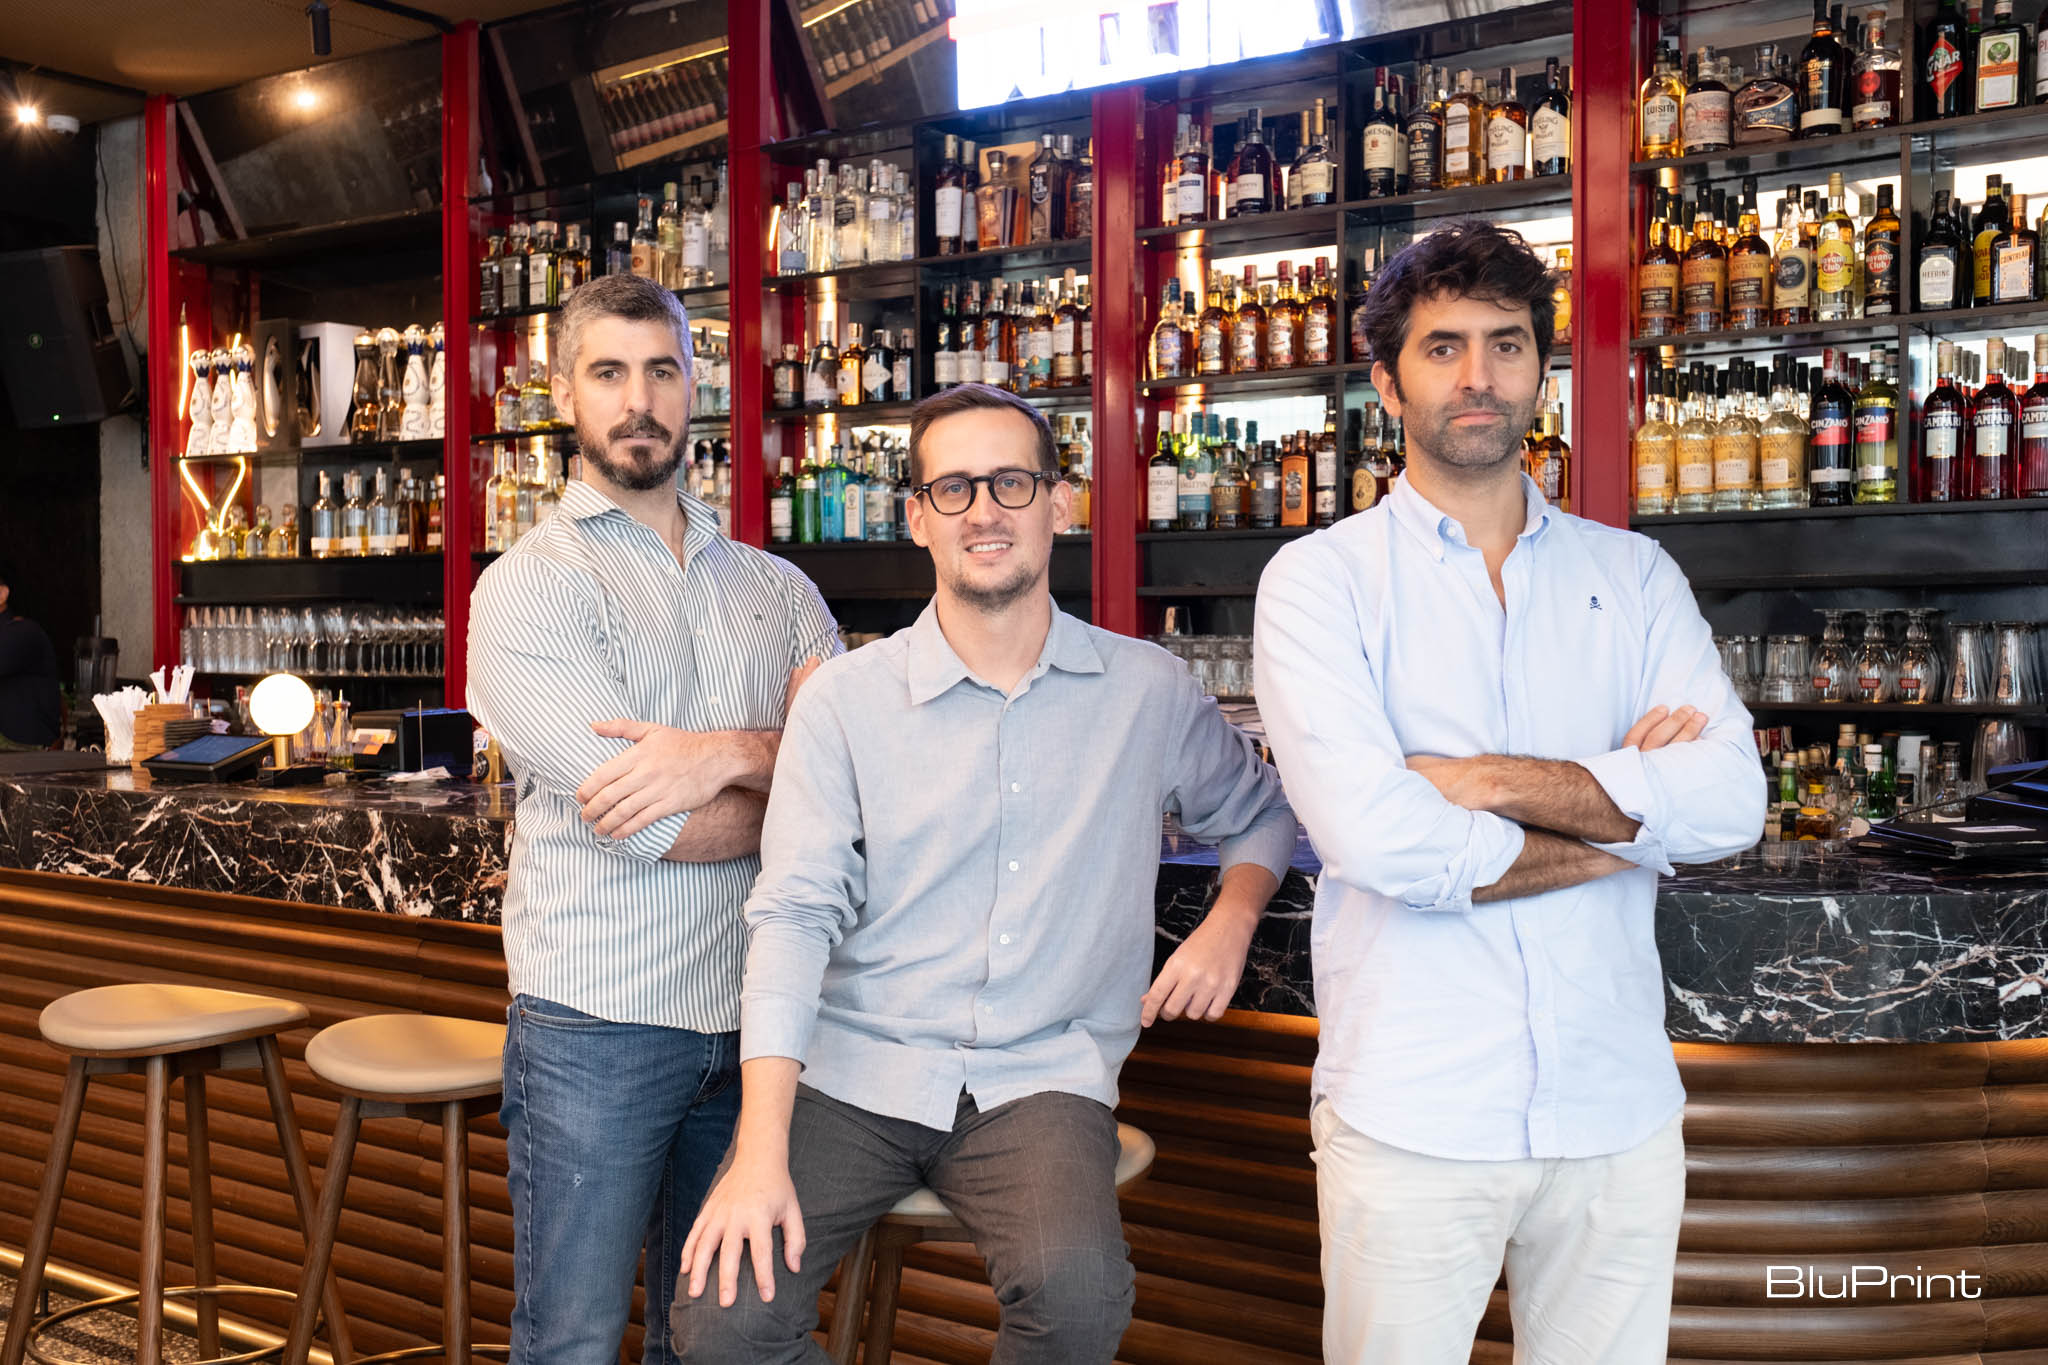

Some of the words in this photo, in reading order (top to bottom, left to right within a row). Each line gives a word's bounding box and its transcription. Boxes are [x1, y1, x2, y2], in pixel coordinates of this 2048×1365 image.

[1366, 128, 1393, 137] AMESON
[1408, 122, 1435, 133] AMESON
[1811, 417, 1848, 429] CINZANO
[1924, 416, 1961, 428] CAMPARI
[1973, 413, 2012, 426] CAMPARI
